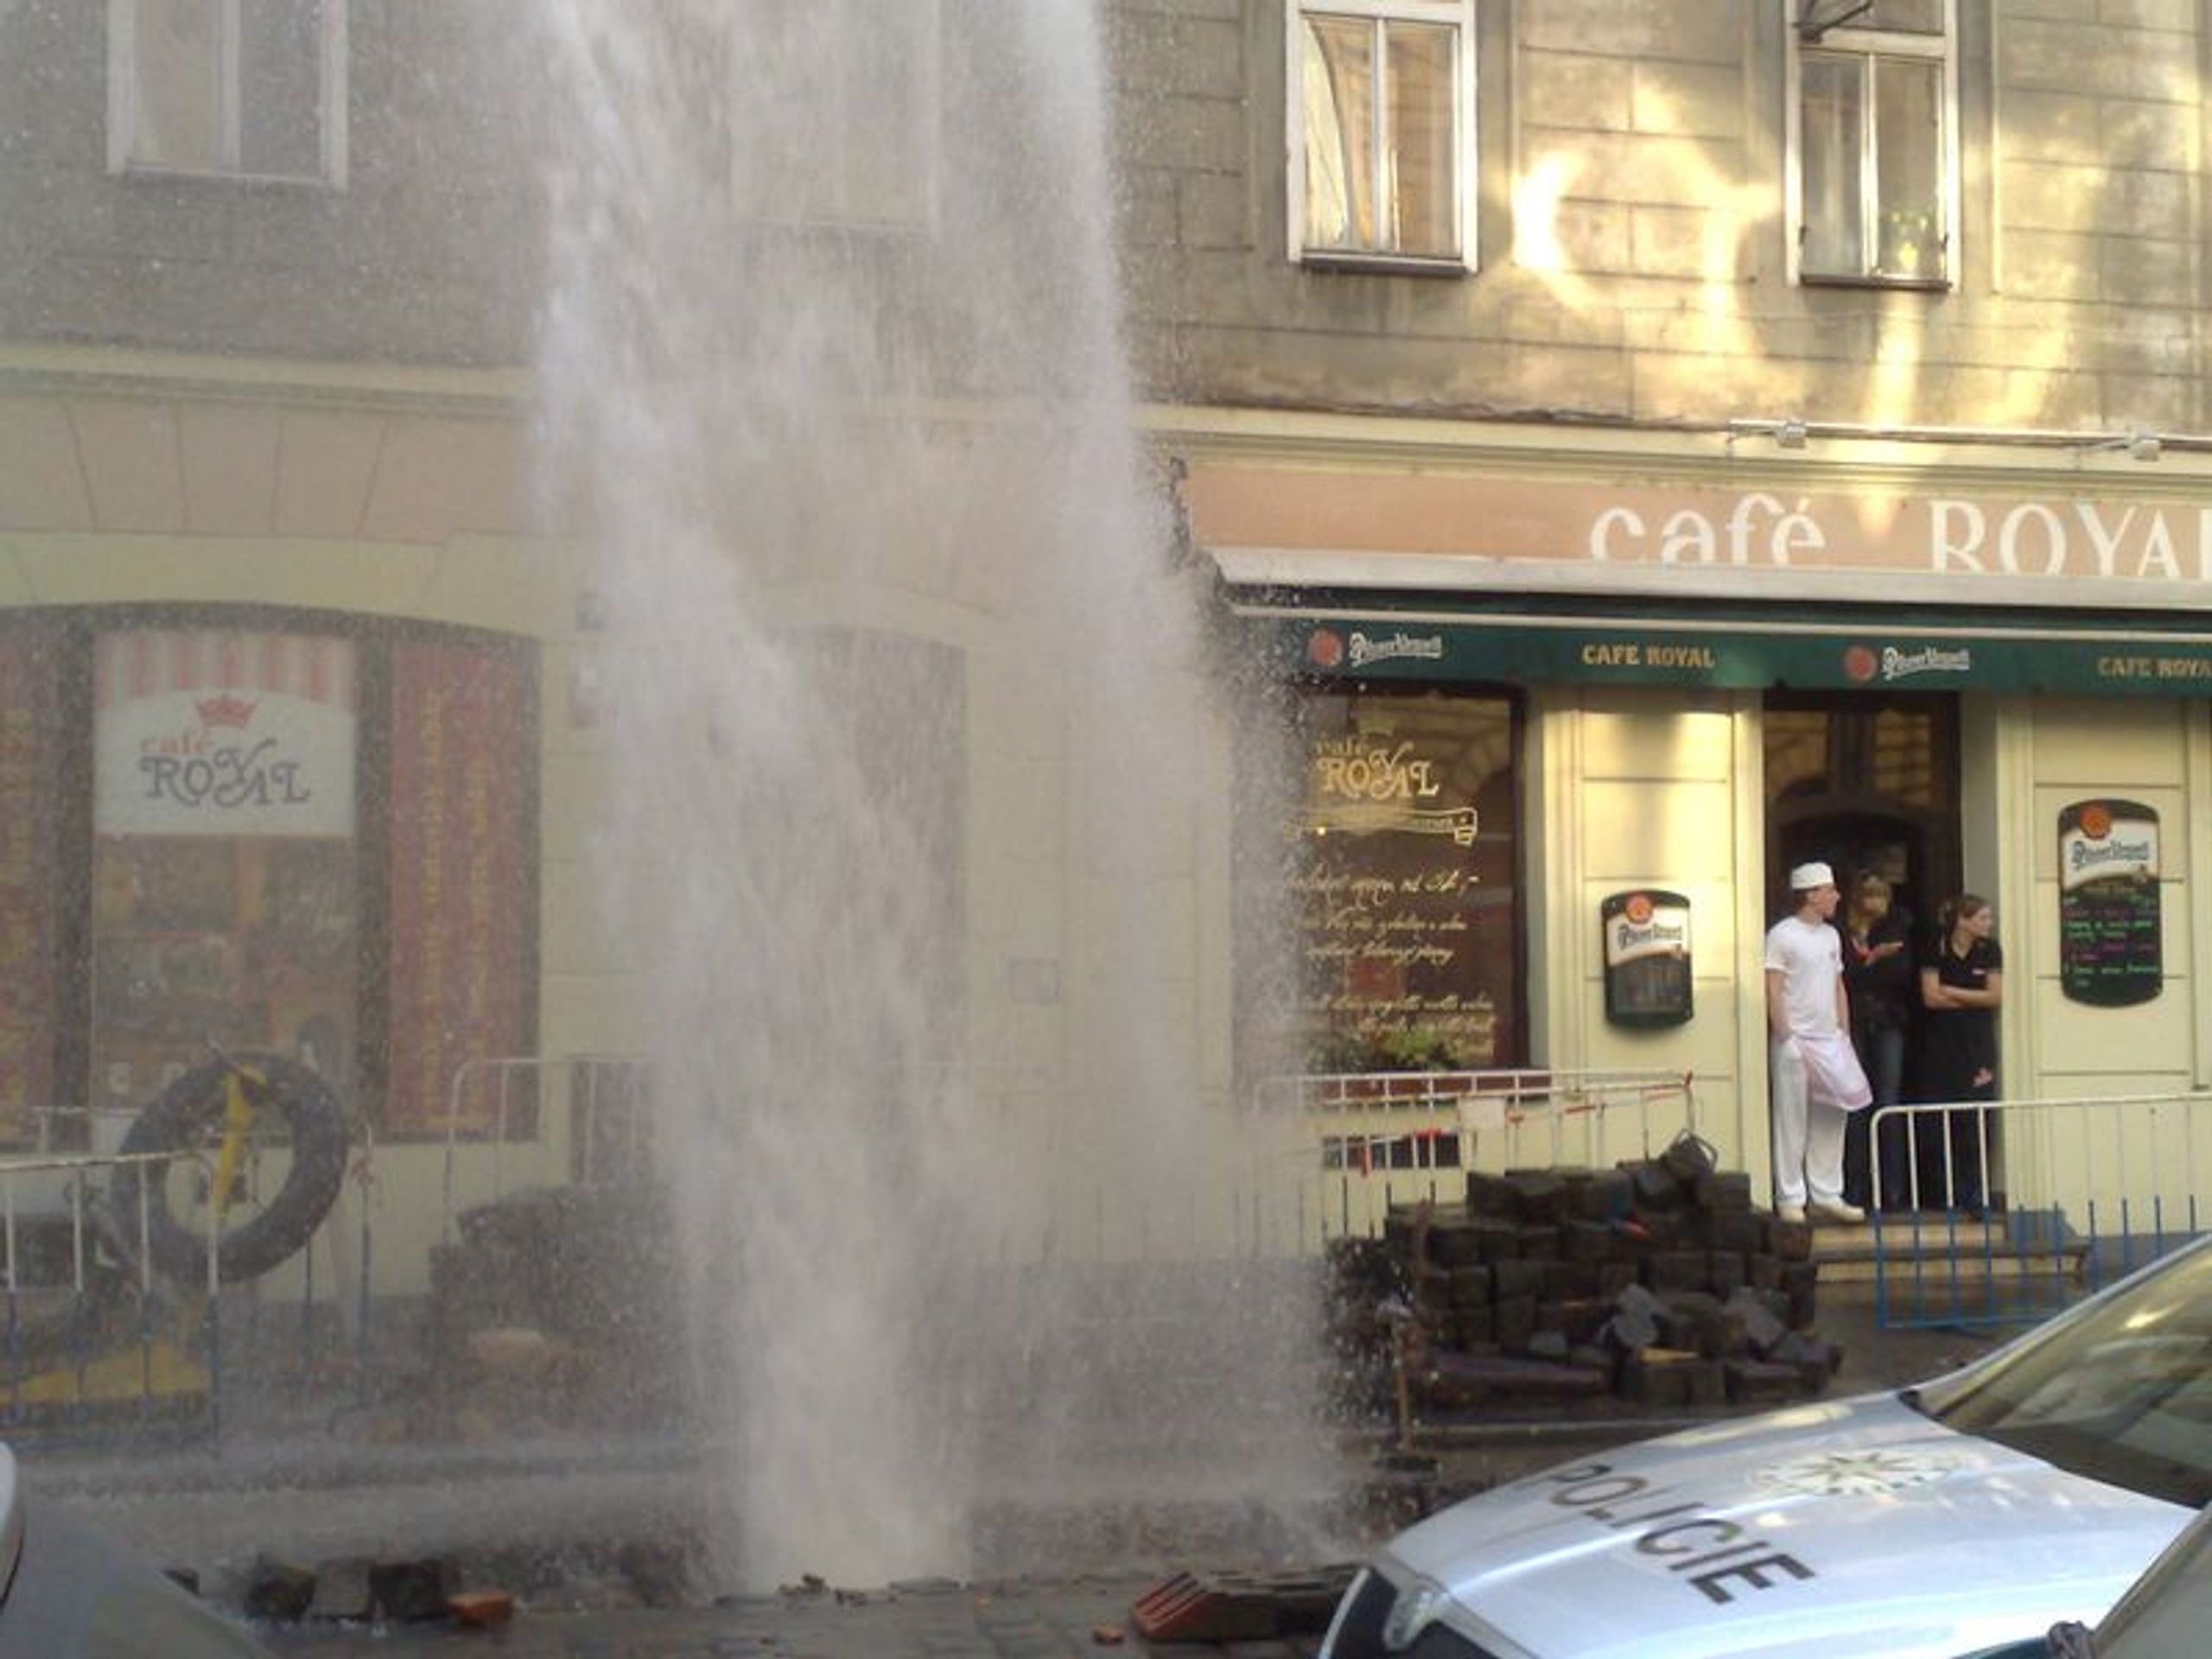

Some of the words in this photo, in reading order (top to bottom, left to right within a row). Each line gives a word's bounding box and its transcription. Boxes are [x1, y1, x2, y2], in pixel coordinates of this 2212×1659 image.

[1590, 492, 1826, 567] café
[1581, 644, 1640, 664] CAFE
[1646, 645, 1715, 668] ROYAL
[139, 737, 311, 808] ROYAL
[1316, 741, 1440, 800] ROYAL
